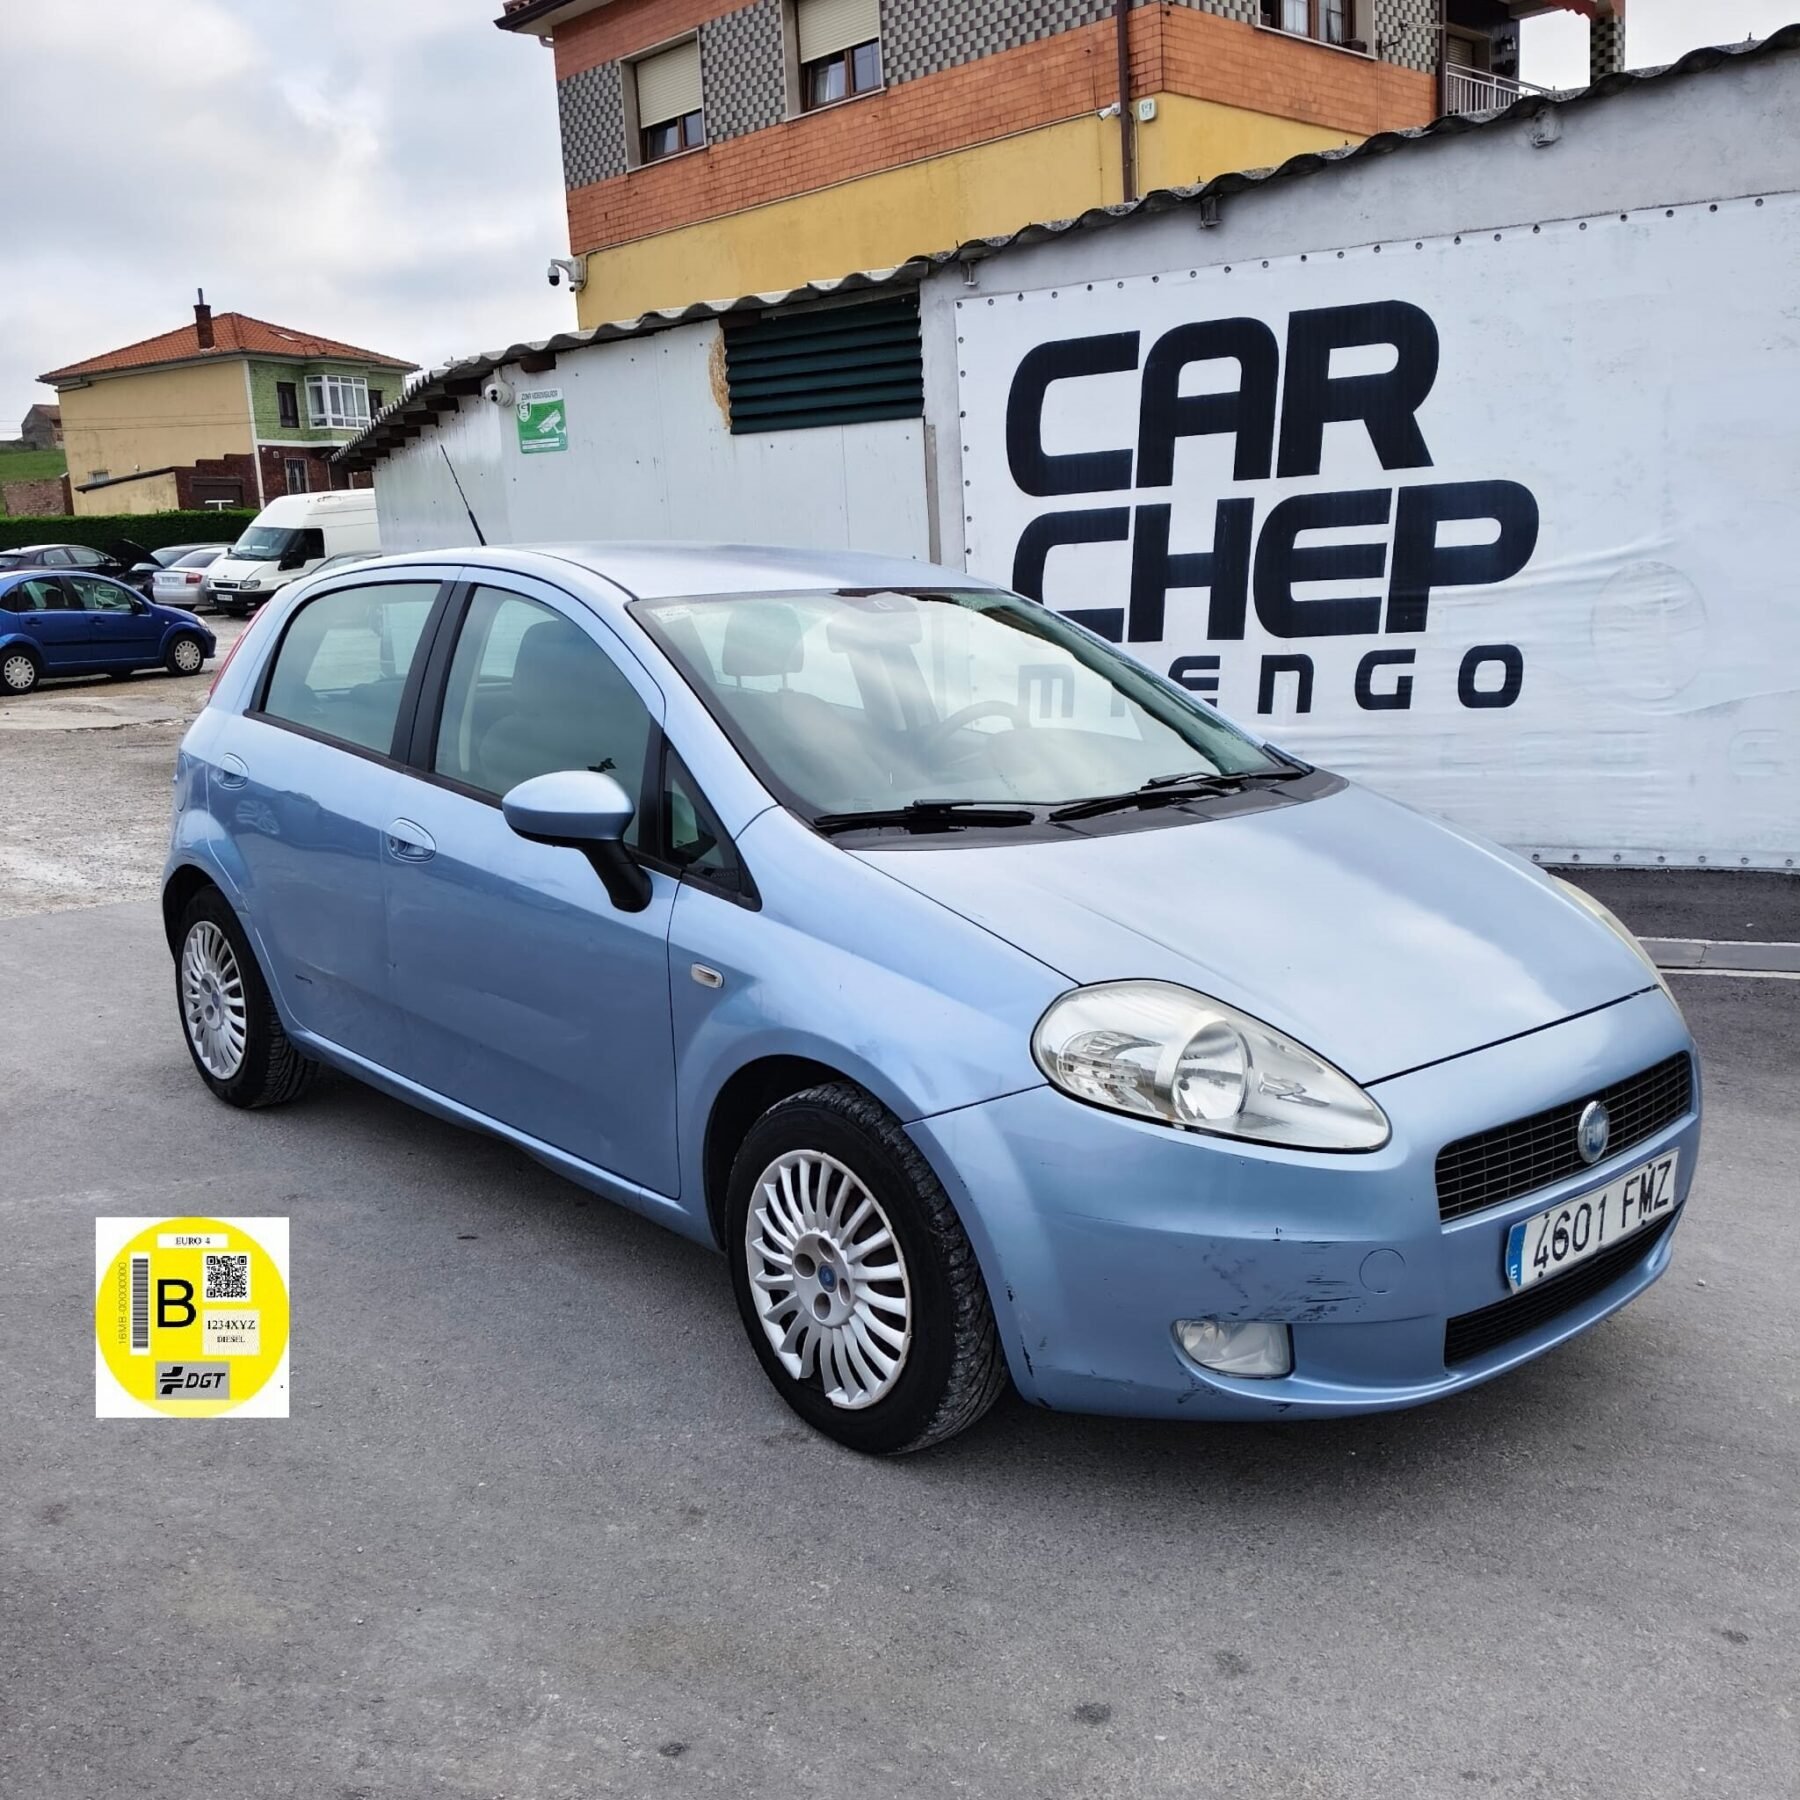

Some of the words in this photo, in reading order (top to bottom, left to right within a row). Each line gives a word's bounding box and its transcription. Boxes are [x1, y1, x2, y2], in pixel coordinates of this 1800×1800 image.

[1006, 300, 1439, 497] CAR
[1012, 479, 1540, 642] CHEP
[1511, 1264, 1518, 1279] E
[1533, 1193, 1607, 1269] 4601
[1622, 1158, 1672, 1228] FMZ
